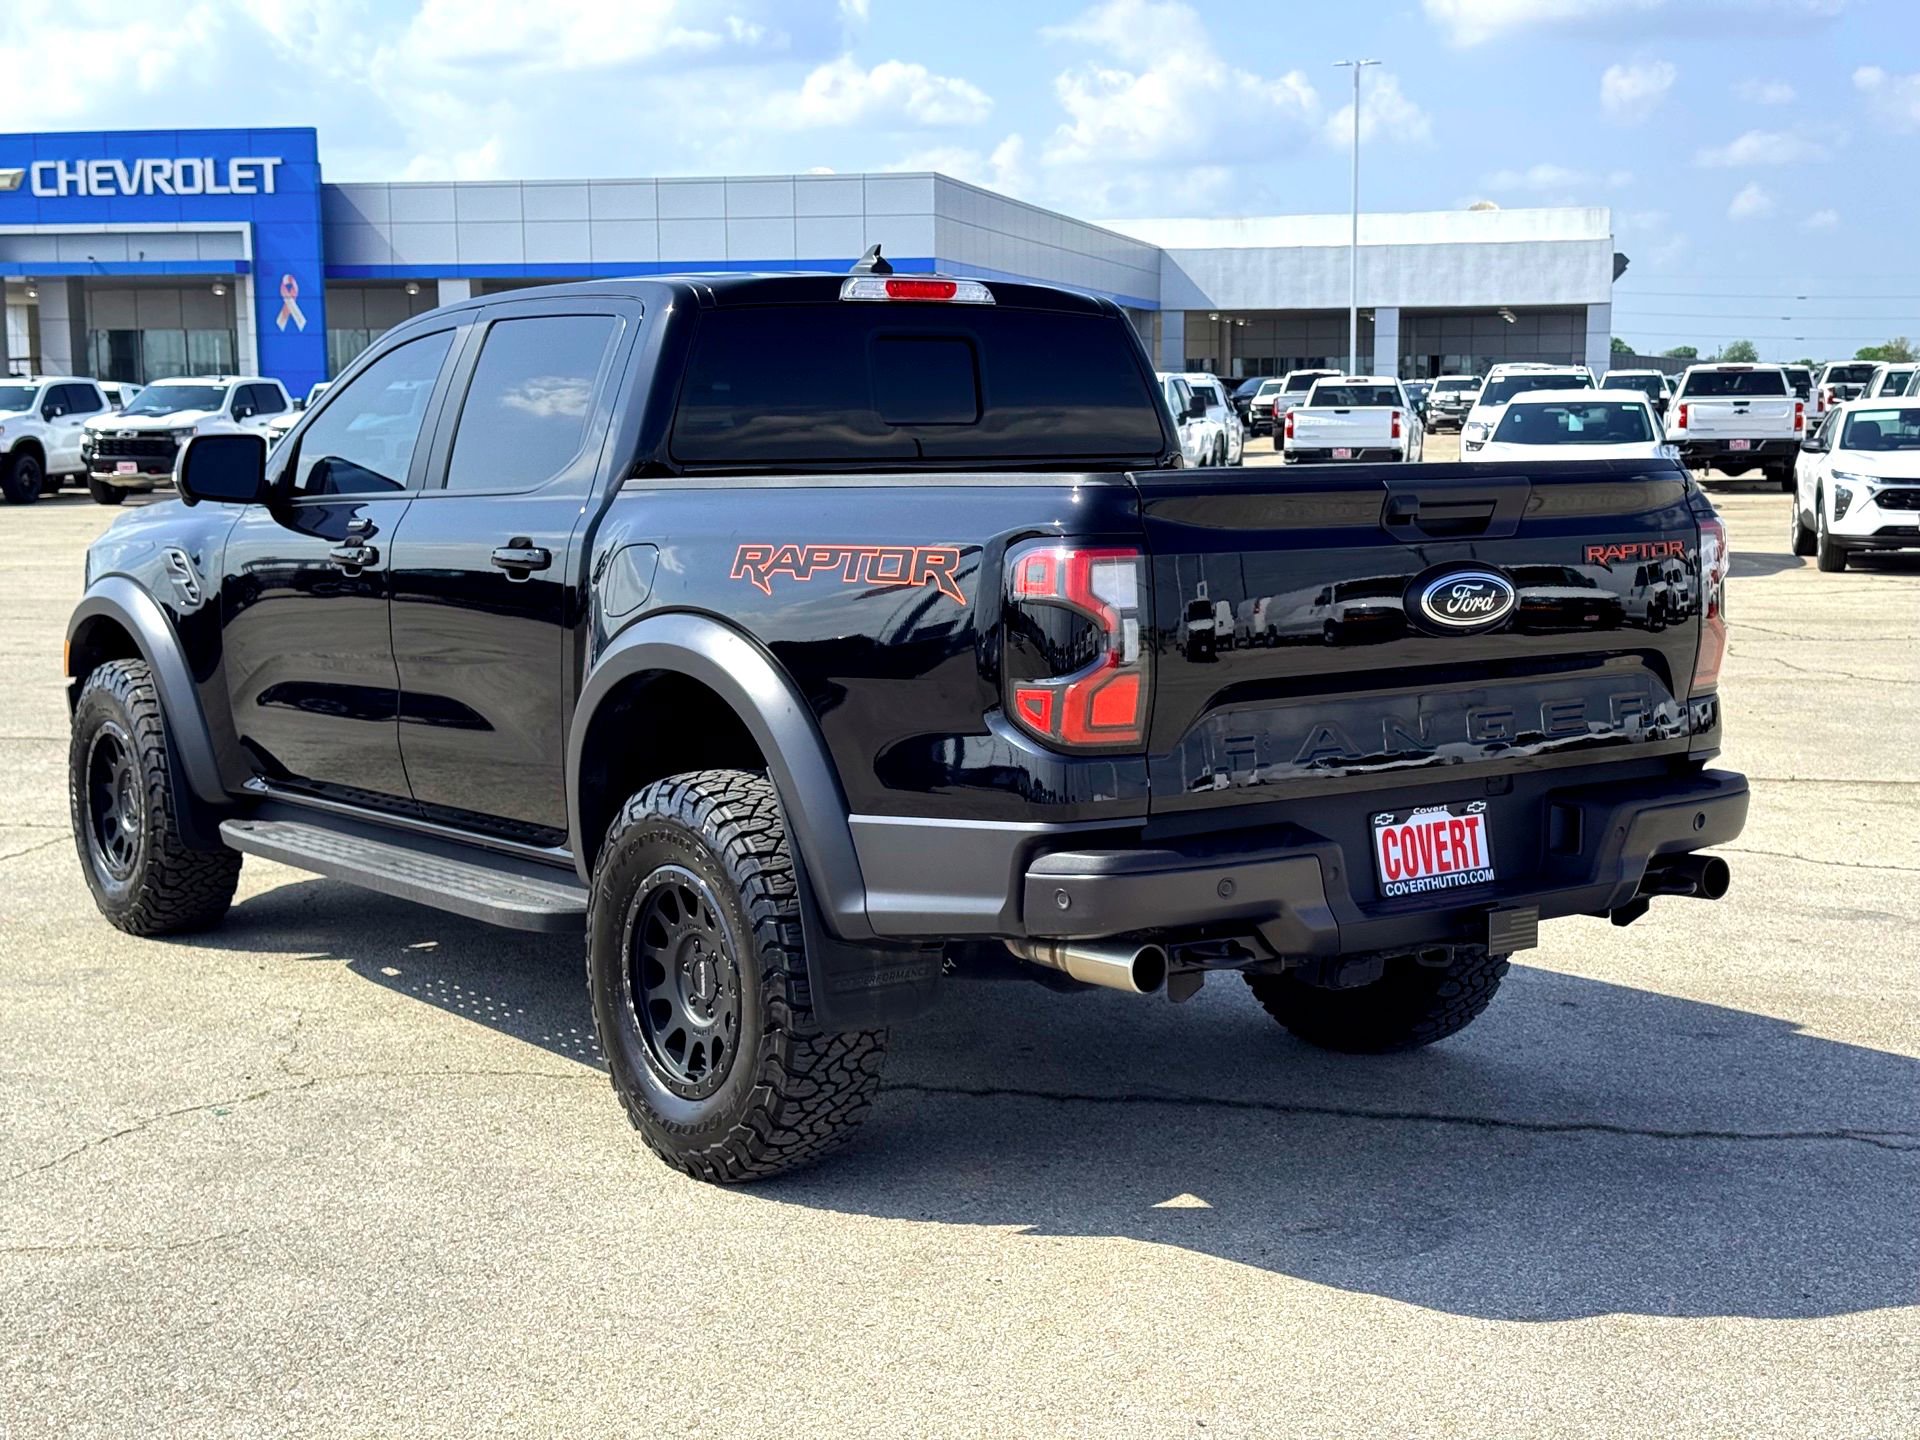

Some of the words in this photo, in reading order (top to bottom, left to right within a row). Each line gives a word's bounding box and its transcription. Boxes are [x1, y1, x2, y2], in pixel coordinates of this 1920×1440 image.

[31, 157, 282, 197] CHEVROLET
[1586, 540, 1688, 568] RAPTOR
[730, 544, 967, 606] RAPTOR
[1446, 584, 1496, 613] Ford
[1214, 693, 1657, 777] RANGER
[1413, 804, 1448, 815] Covert
[1382, 816, 1479, 881] COVERT
[1385, 868, 1495, 897] COVERTHUTTO.COM
